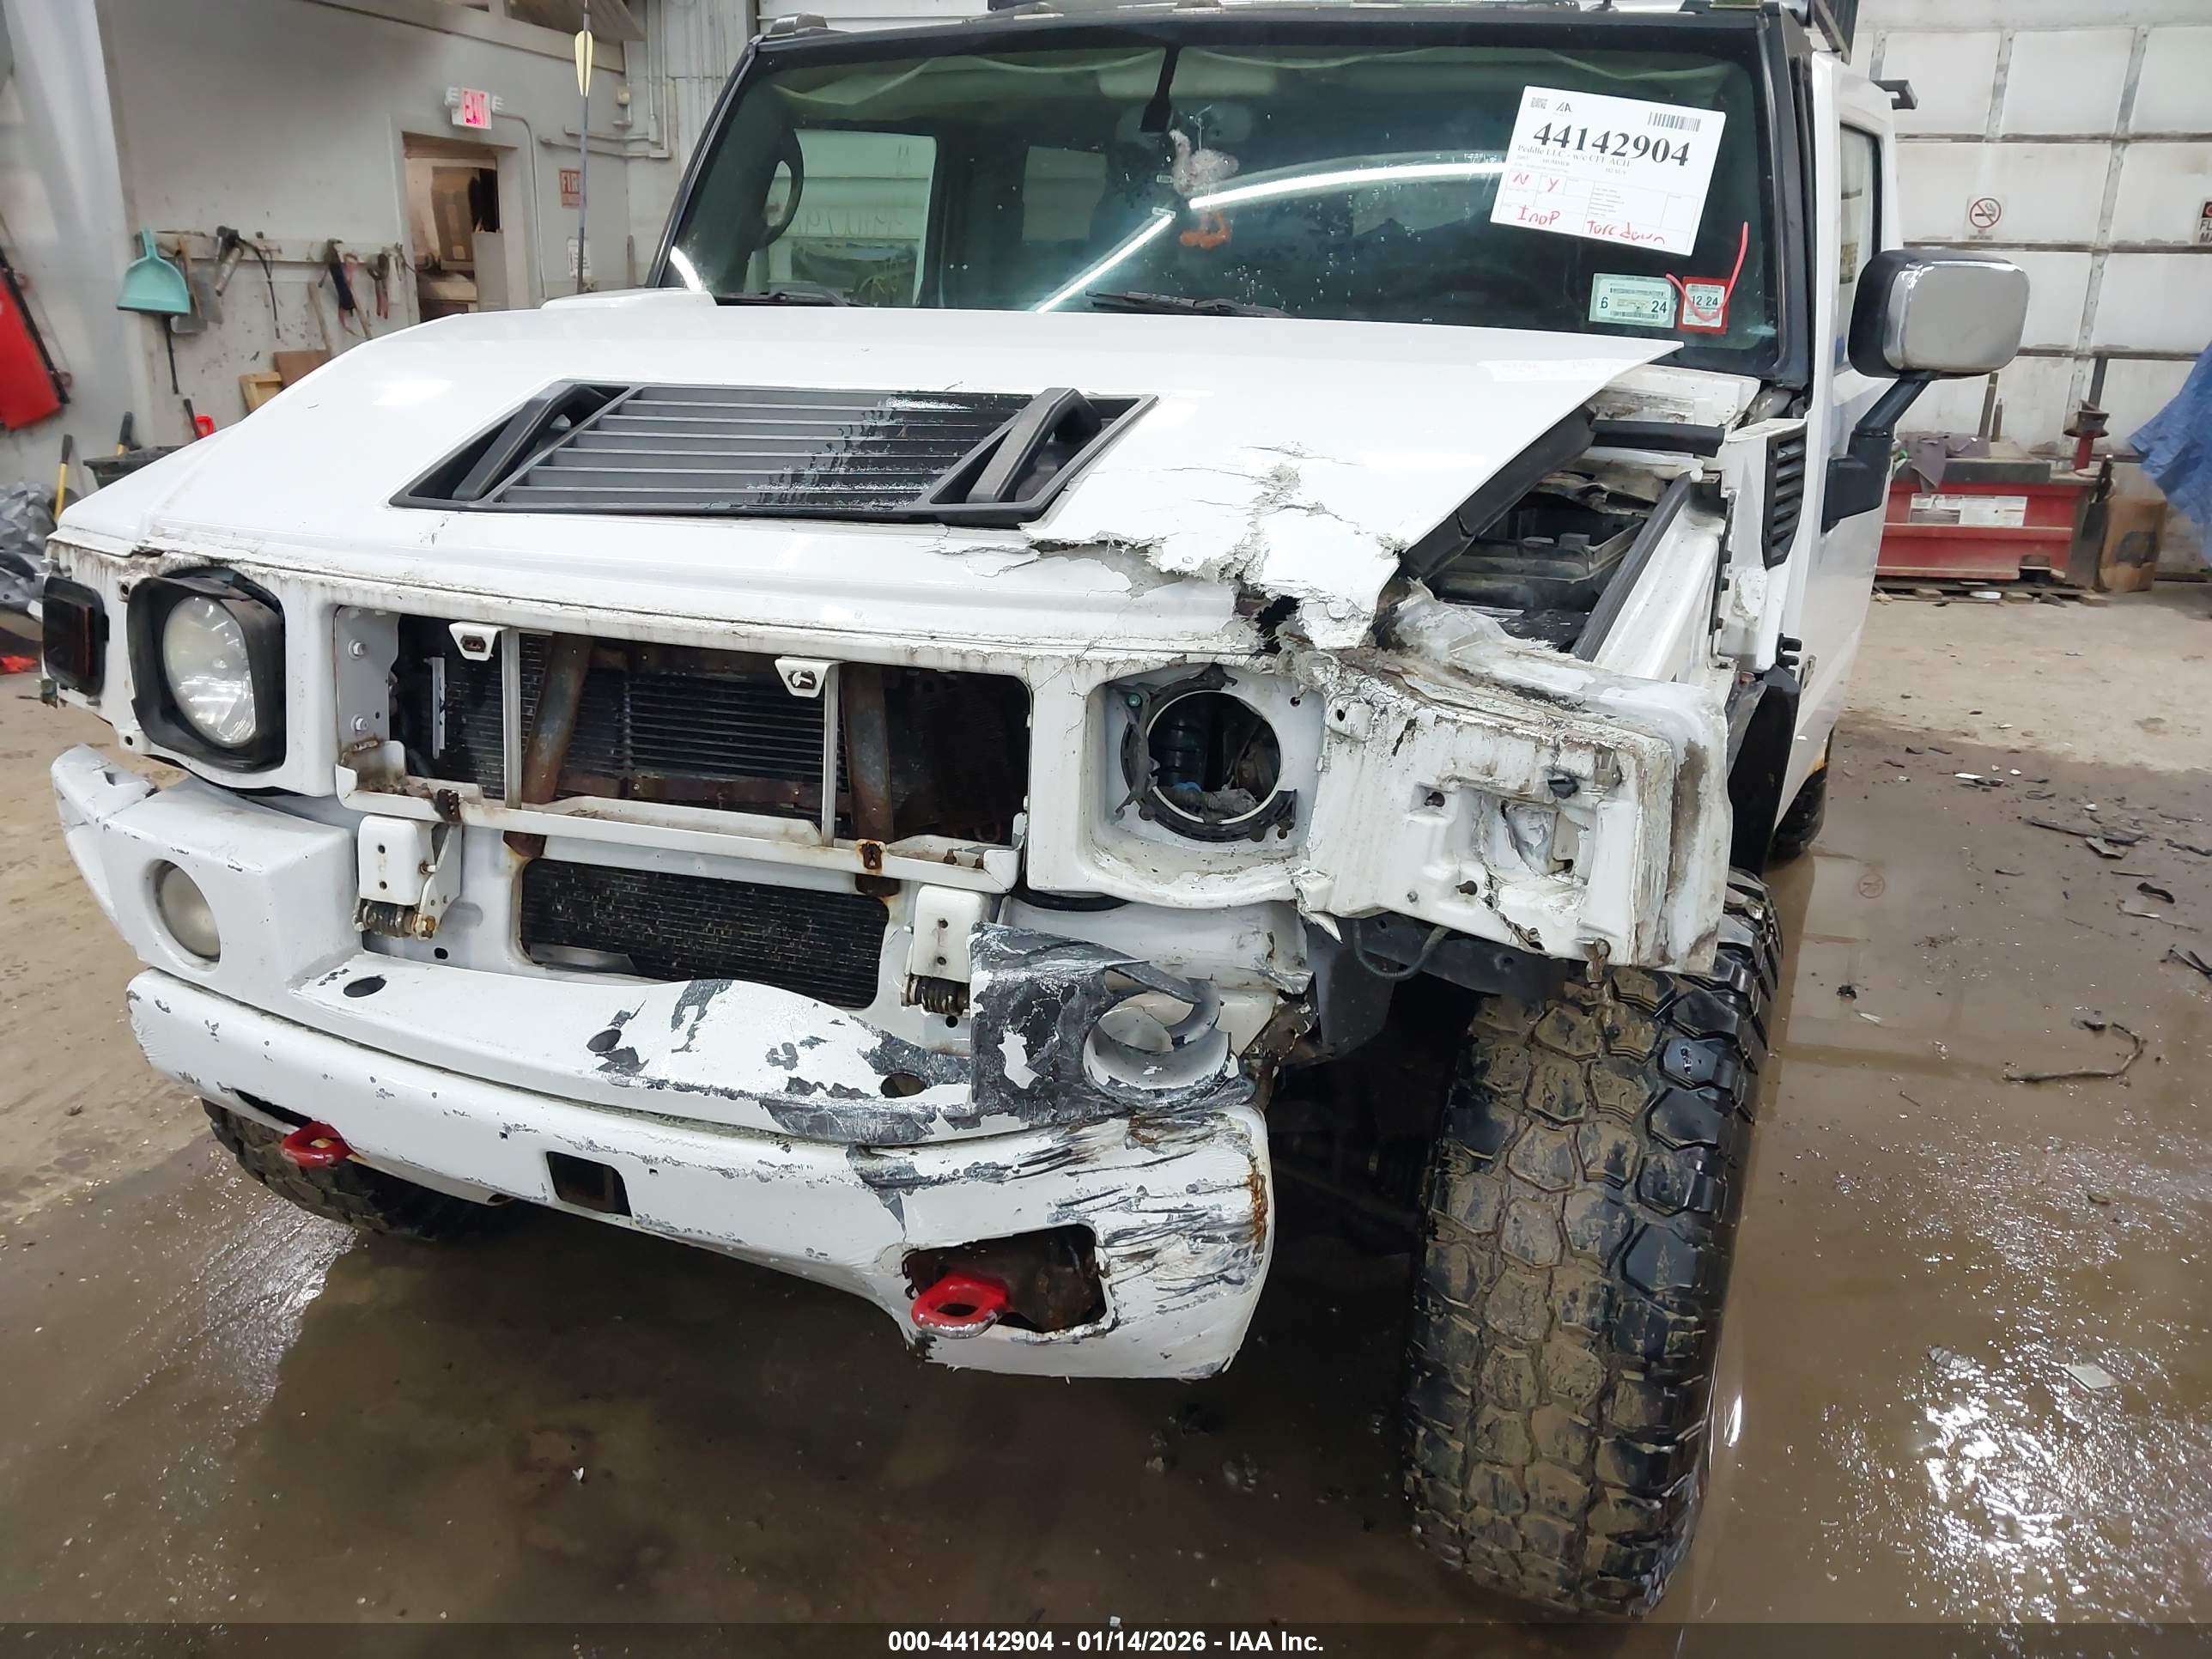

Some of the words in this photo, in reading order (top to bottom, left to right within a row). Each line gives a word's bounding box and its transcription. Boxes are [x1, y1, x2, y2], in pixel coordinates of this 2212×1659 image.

[1533, 122, 1690, 167] 44142904
[1512, 173, 1528, 185] N
[1547, 178, 1560, 192] Y
[1601, 296, 1608, 308] 6
[1650, 300, 1668, 314] 24
[1692, 295, 1703, 306] 12
[1706, 296, 1718, 307] 24
